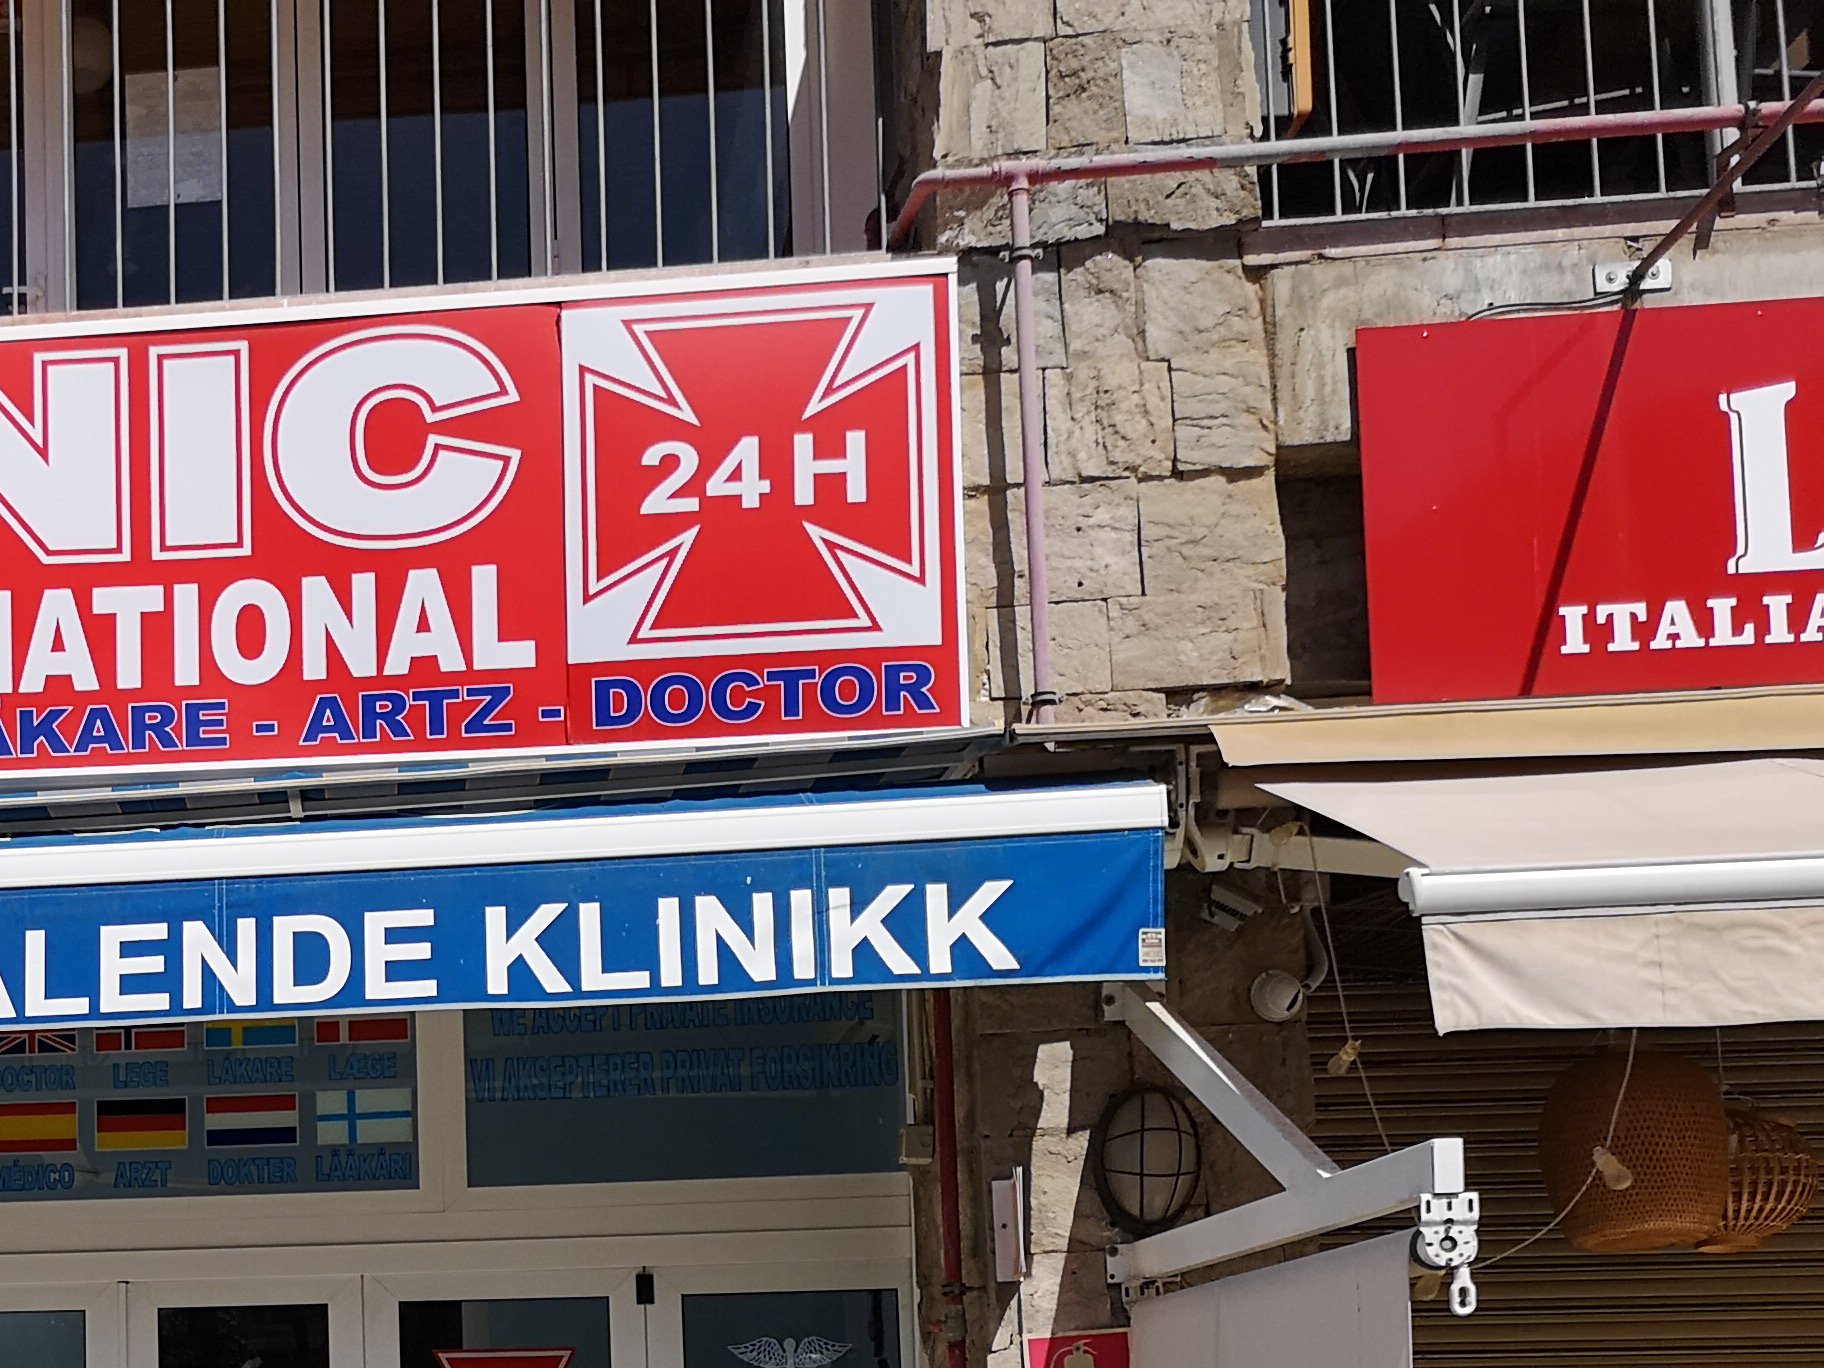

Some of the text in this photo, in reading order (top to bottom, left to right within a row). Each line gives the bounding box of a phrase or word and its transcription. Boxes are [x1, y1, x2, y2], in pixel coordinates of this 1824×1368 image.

[300, 684, 516, 747] ARTZ
[593, 661, 940, 730] DOCTOR
[485, 878, 1021, 998] KLINIKK
[112, 1061, 170, 1089] LEGE
[661, 1048, 744, 1095] PRIVAT
[113, 1160, 173, 1189] ARZT
[207, 1157, 298, 1186] DOKTER
